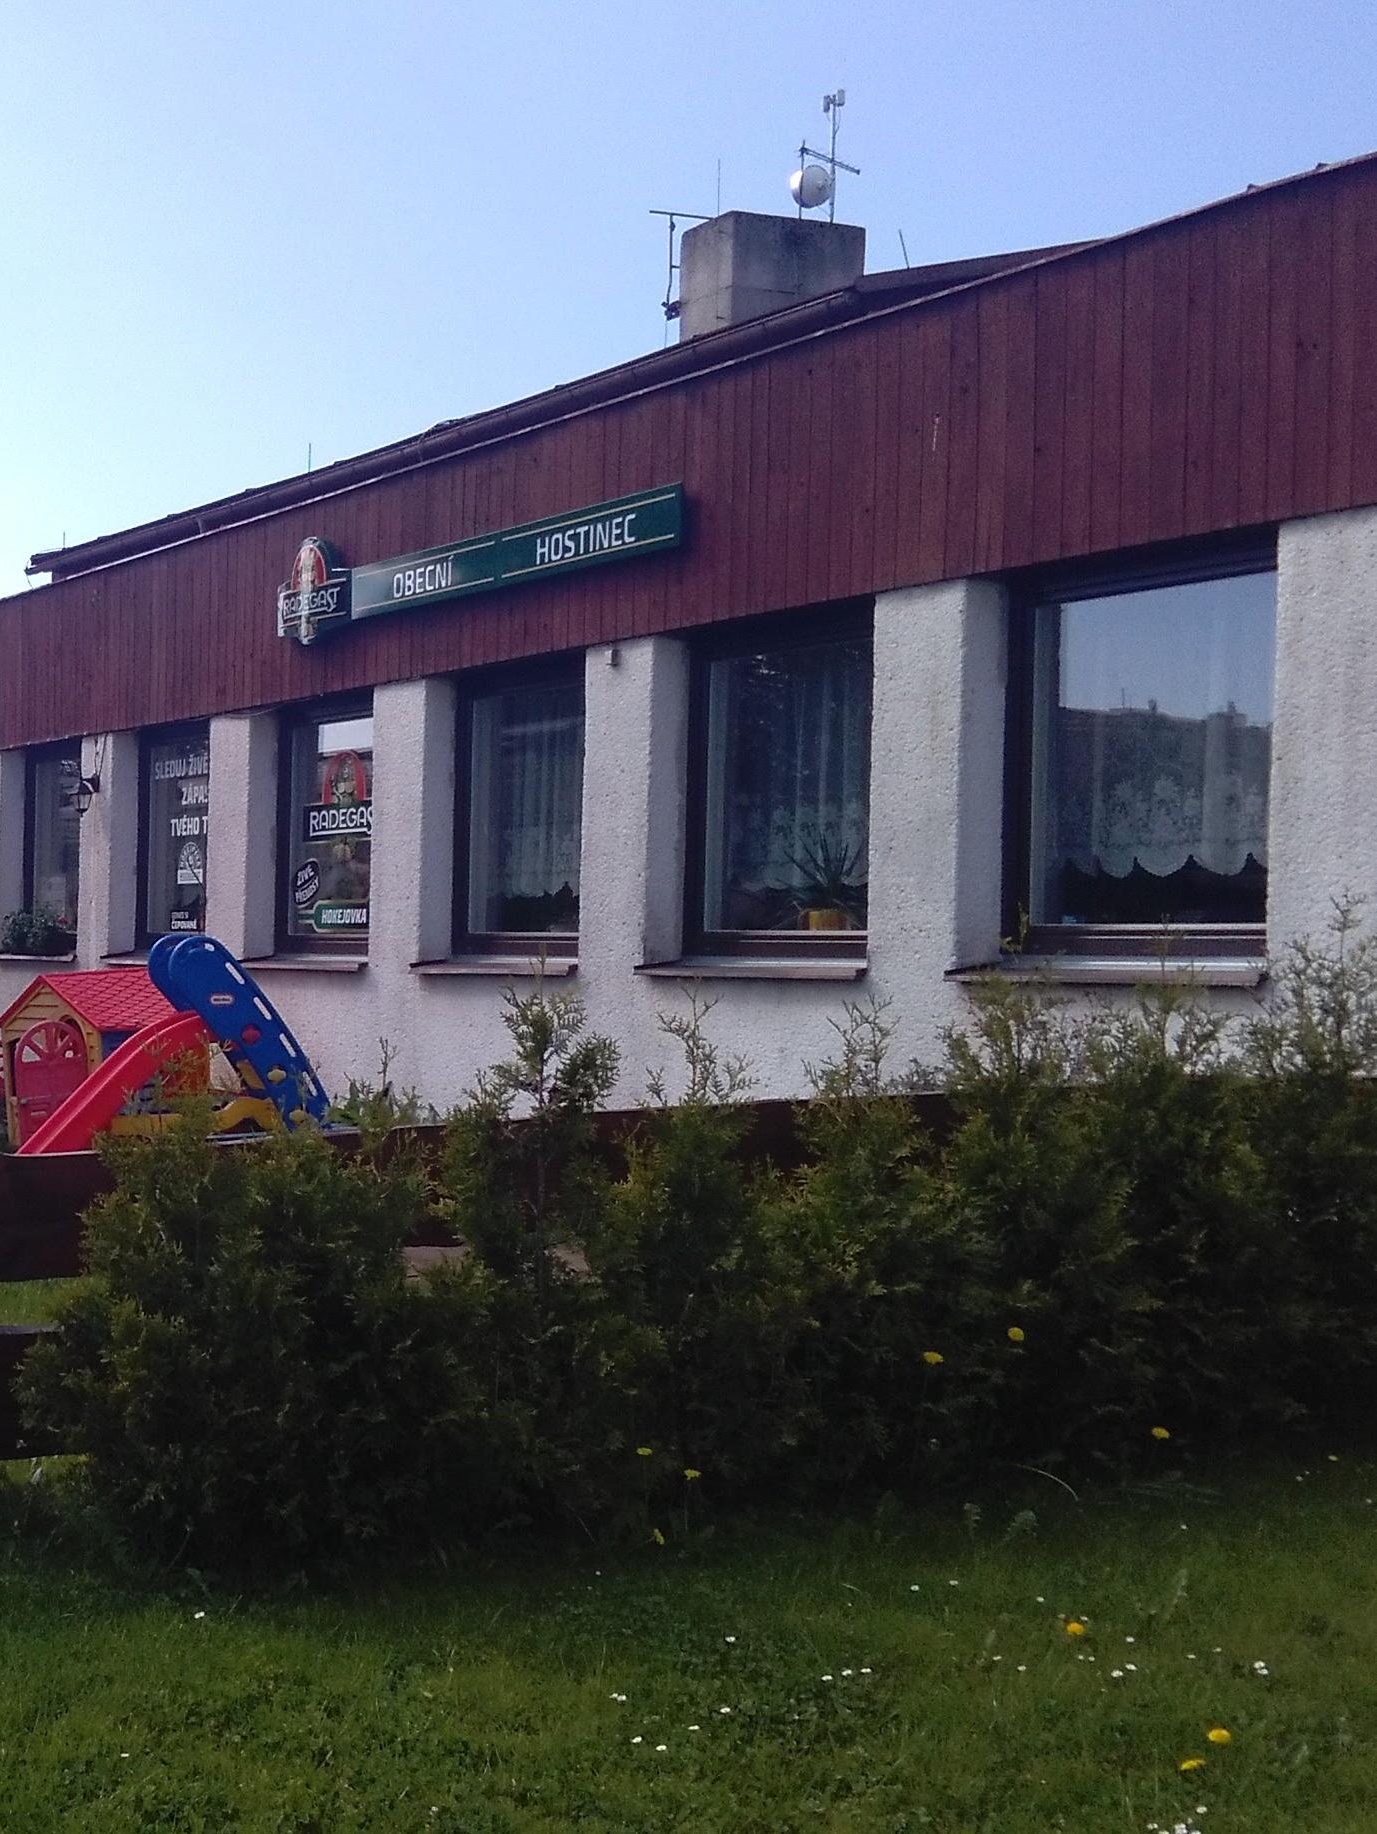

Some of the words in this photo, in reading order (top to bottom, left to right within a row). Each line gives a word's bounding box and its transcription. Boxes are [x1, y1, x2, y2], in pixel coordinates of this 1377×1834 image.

[393, 555, 454, 598] OBECNÍ
[536, 513, 637, 565] HOSTINEC
[283, 586, 341, 619] RADEGAST
[155, 758, 185, 780] SLEDUJ
[170, 814, 200, 837] TVÉHO
[321, 908, 367, 924] HOKEJOVKA
